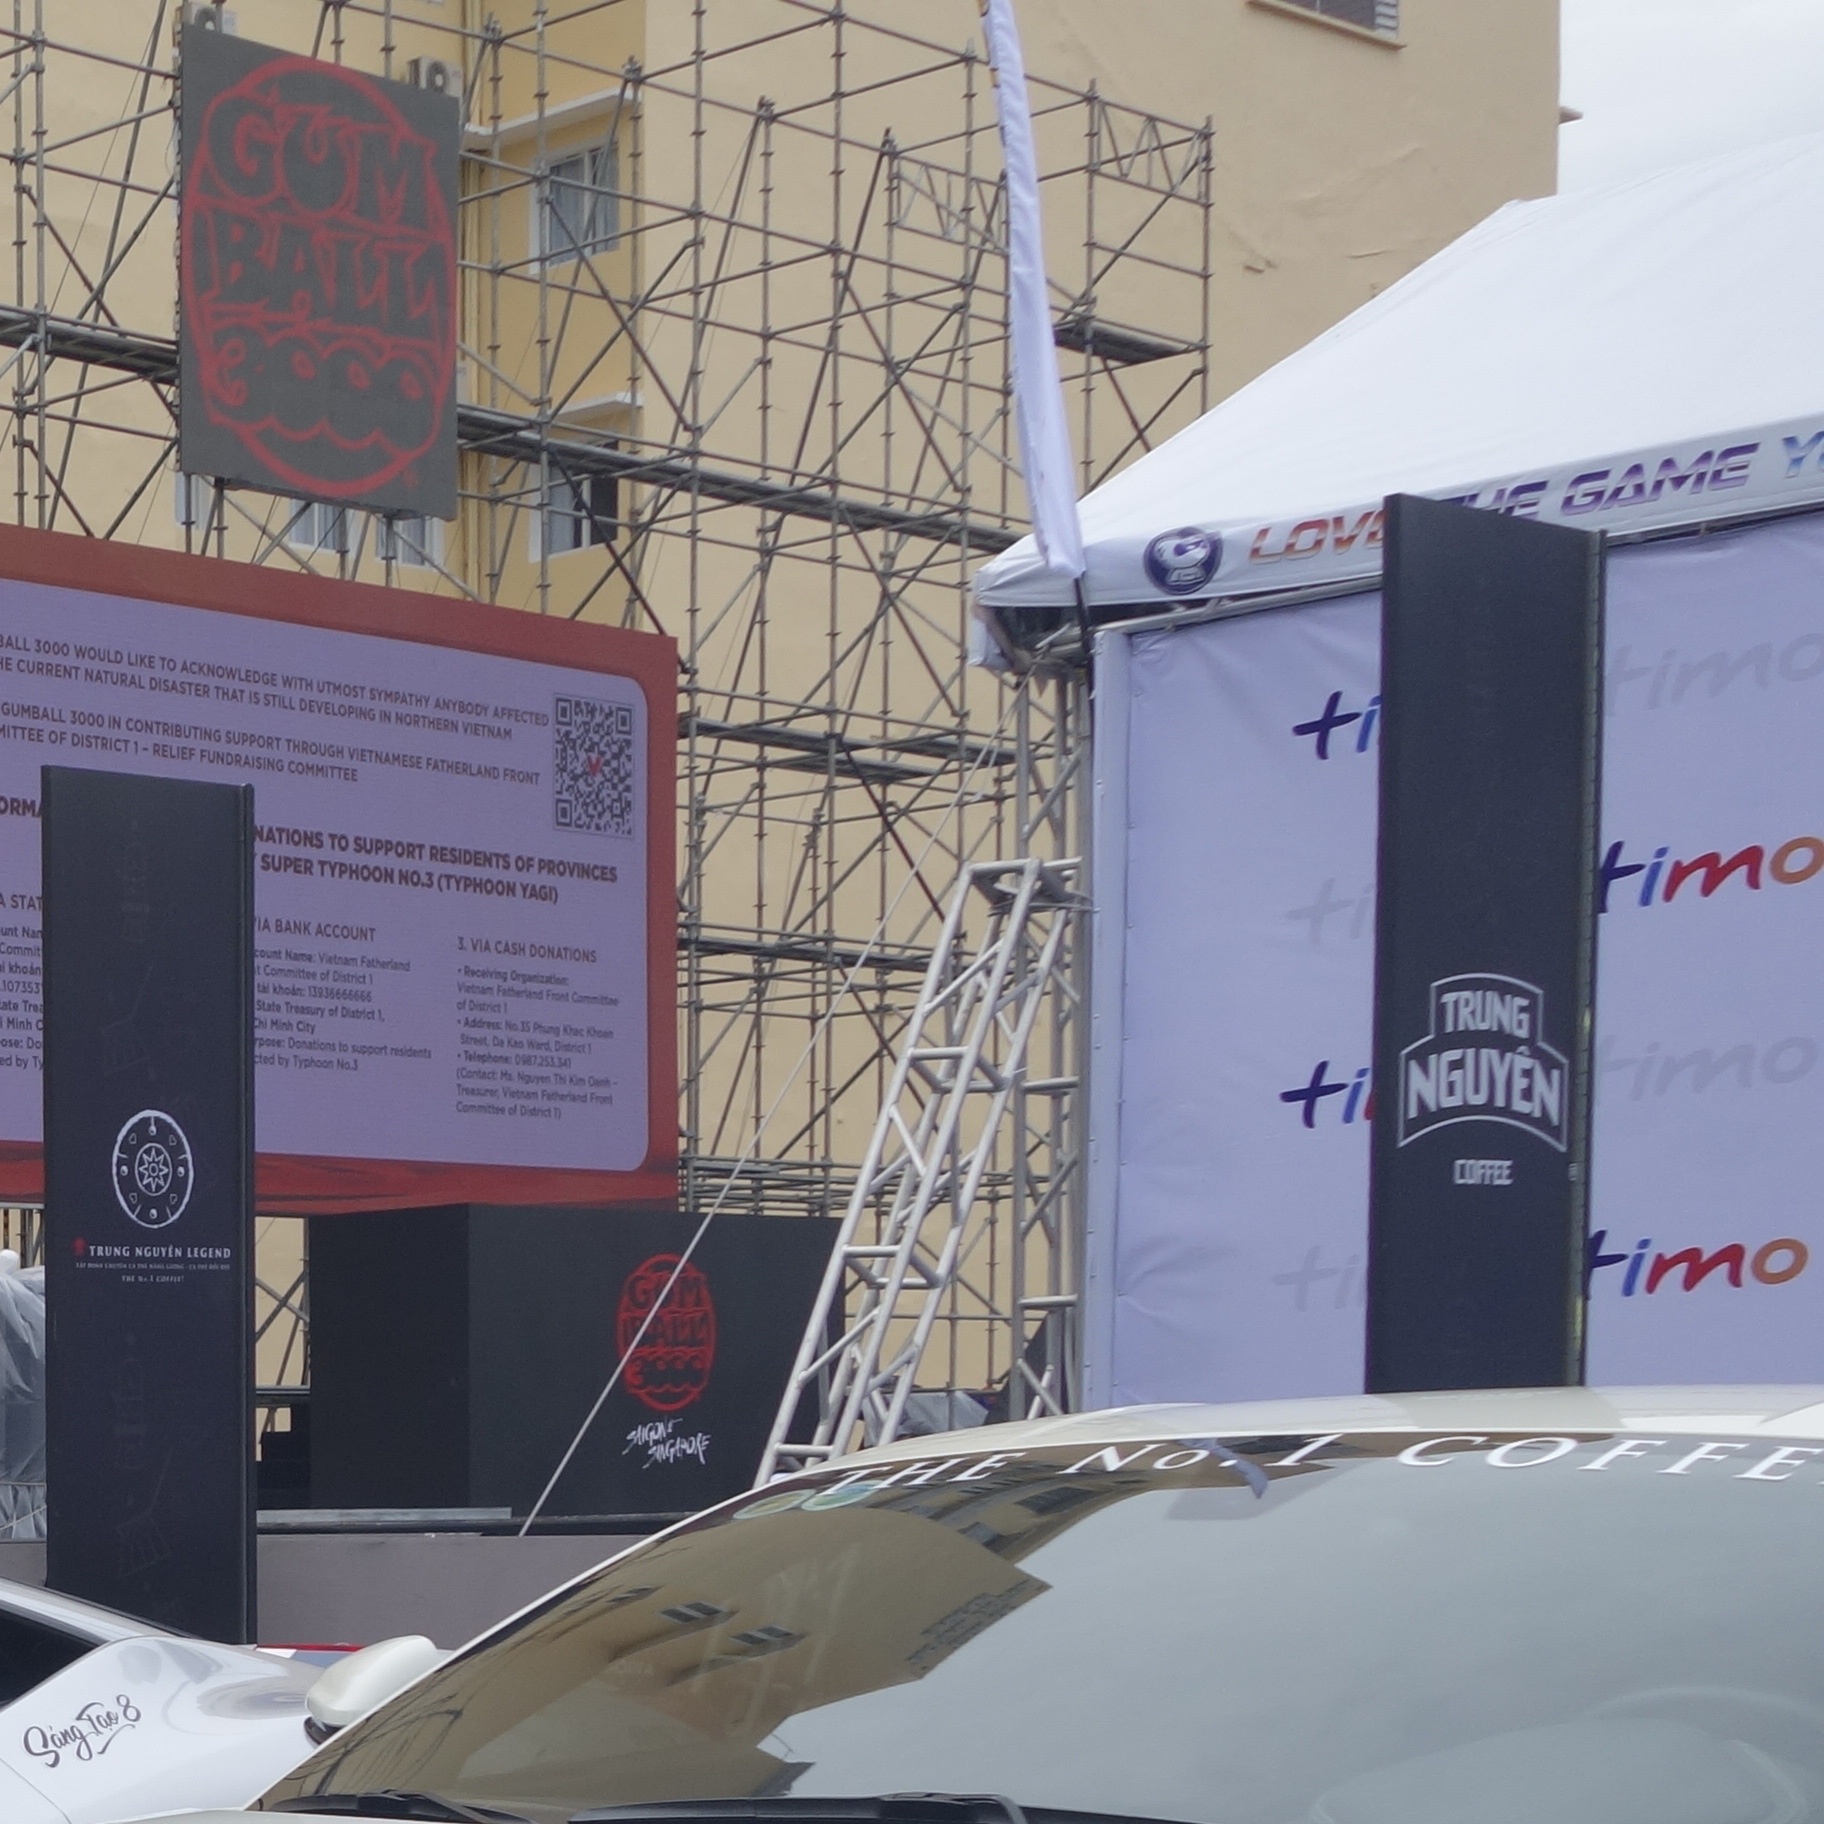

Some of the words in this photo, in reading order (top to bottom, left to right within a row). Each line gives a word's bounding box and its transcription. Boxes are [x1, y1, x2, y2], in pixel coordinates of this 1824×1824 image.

[204, 85, 440, 234] GUM
[197, 207, 450, 343] BALL
[209, 321, 441, 455] 3000
[1559, 442, 1759, 516] GAME
[16, 657, 79, 681] CURRENT
[84, 667, 144, 690] NATURAL
[149, 676, 210, 699] DISASTER
[214, 685, 244, 703] THAT
[248, 690, 260, 706] IS
[263, 692, 295, 711] STILL
[298, 698, 375, 722] DEVELOPING
[379, 709, 391, 724] IN
[395, 711, 458, 733] NORTHERN
[462, 721, 512, 741] VIETNAM
[34, 638, 69, 657] 3000
[73, 643, 123, 665] WOULD
[127, 651, 155, 669] LIKE
[159, 655, 176, 672] TO
[180, 659, 277, 687] ACKNOWLEDGE
[281, 674, 313, 692] WITH
[316, 679, 365, 699] UTMOST
[369, 686, 430, 708] SYMPATHY
[434, 696, 489, 717] ANYBODY
[493, 705, 548, 726] AFFECTED
[0, 701, 65, 723] GUMBALL
[70, 709, 104, 728] 3000
[107, 714, 121, 730] IN
[125, 716, 221, 743] CONTRIBUTING
[225, 729, 281, 750] SUPPORT
[285, 738, 344, 759] THROUGH
[348, 746, 422, 769] VIETNAMESE
[425, 756, 500, 780] FATHERLAND
[502, 767, 539, 785] FRONT
[48, 729, 66, 745] OF
[70, 732, 129, 753] DISTRICT
[134, 740, 138, 755] 1
[152, 742, 195, 761] RELIEF
[199, 748, 284, 773] FUNDRAISING
[287, 760, 358, 782] COMMITTEE
[254, 823, 324, 849] NATIONS
[328, 832, 349, 852] TO
[353, 835, 425, 859] SUPPORT
[429, 844, 510, 869] RESIDENTS
[514, 854, 534, 873] OF
[537, 857, 617, 883] PROVINCES
[261, 853, 313, 876] SUPER
[318, 860, 394, 884] TYPHOON
[398, 868, 433, 888] NO.3
[437, 873, 516, 898] (TYPHOON
[520, 882, 558, 902] YAGI)
[457, 935, 466, 951] 3.
[470, 937, 491, 953] VIA
[494, 939, 526, 956] CASH
[529, 943, 597, 963] DONATIONS
[1441, 990, 1530, 1040] TRUNG
[1407, 1045, 1561, 1127] NGUYÊN
[1454, 1160, 1512, 1185] COFFEE
[89, 1245, 130, 1257] TRUNG
[135, 1244, 182, 1258] NGUYÊN
[187, 1247, 231, 1259] LEGEND
[642, 1432, 711, 1469] SINGAPORE
[824, 1451, 1032, 1494] THE
[1066, 1434, 1339, 1475] No.1
[1399, 1435, 1824, 1486] COFFE
[116, 1694, 141, 1723] 8
